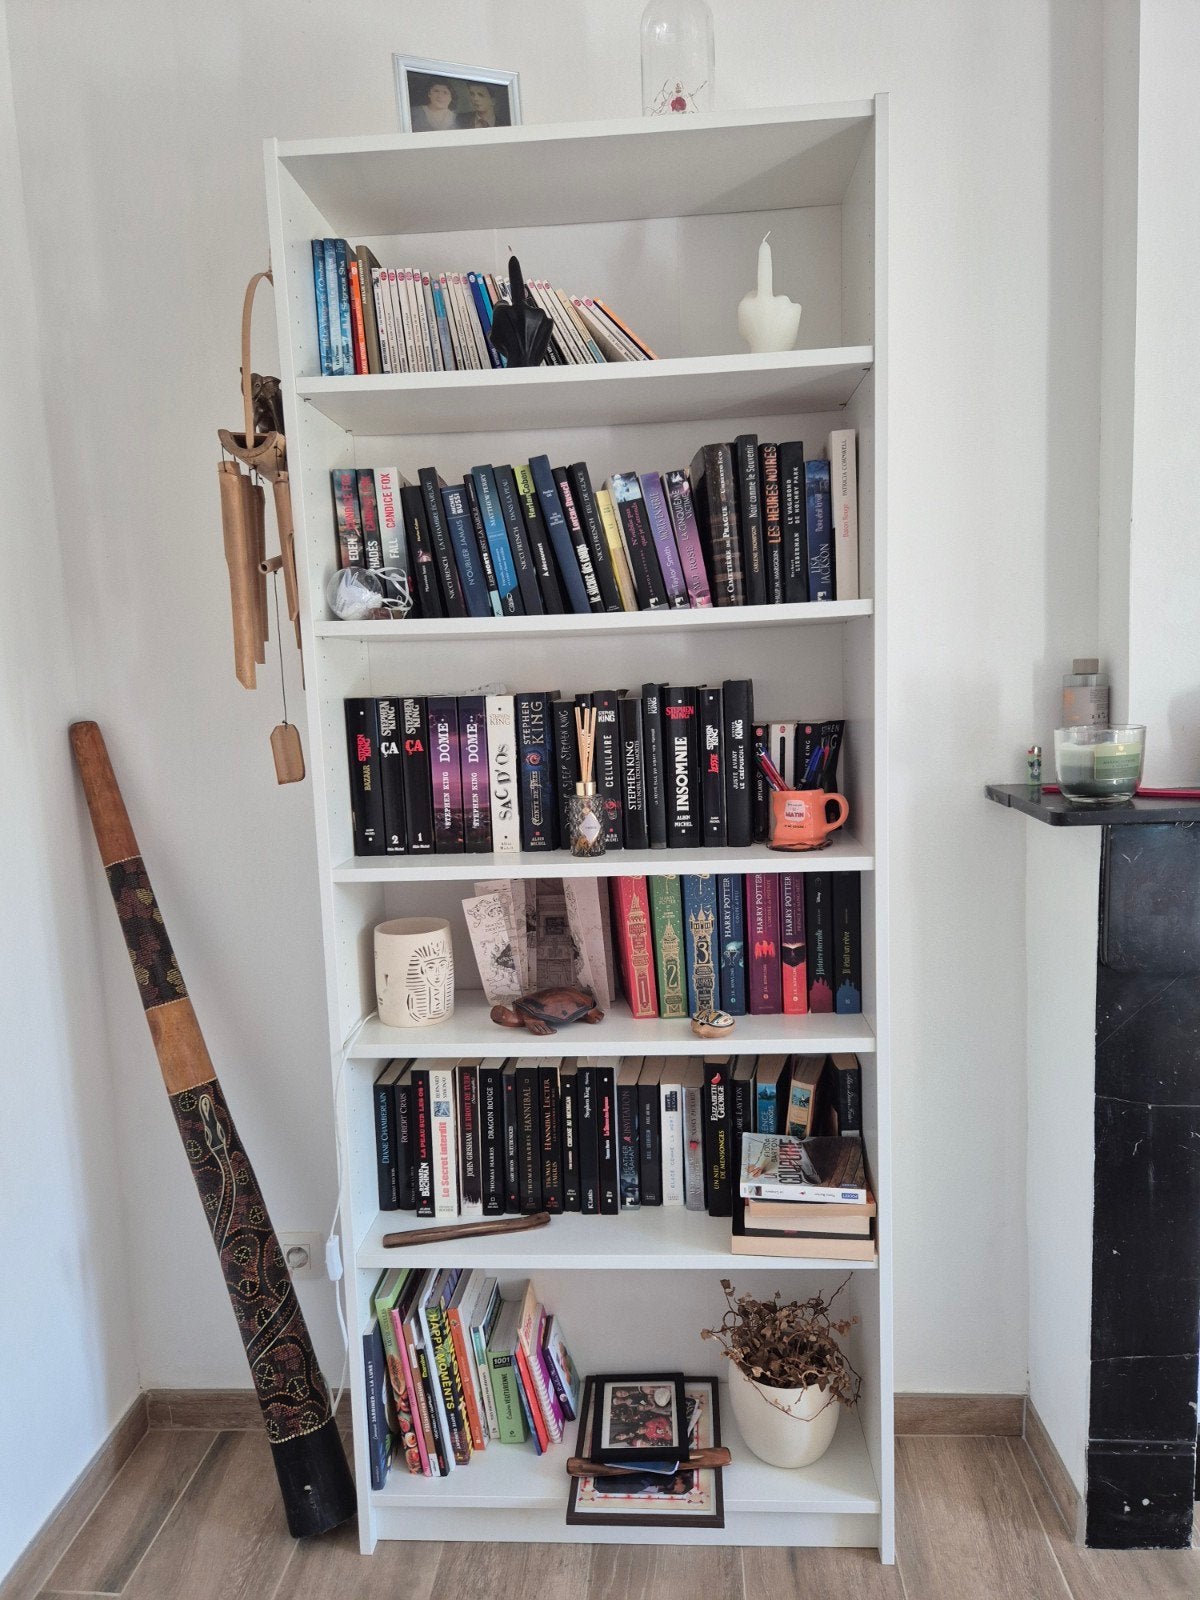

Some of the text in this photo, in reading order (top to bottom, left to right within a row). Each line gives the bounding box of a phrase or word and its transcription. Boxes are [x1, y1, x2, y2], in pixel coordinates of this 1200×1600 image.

[746, 444, 754, 472] Souvenir
[520, 470, 530, 494] Coben
[560, 482, 574, 506] Russell
[748, 481, 757, 502] comme
[764, 446, 781, 544] LES HEURES NOIRES
[341, 474, 356, 530] CANDICE FOX
[363, 495, 375, 531] CANDICE
[381, 473, 396, 528] CANDICE FOX
[449, 494, 457, 514] MICHEL
[453, 492, 464, 514] BUSSI
[480, 473, 497, 526] MATTHEW PERRY
[748, 504, 758, 517] Noir
[432, 511, 444, 541] CHAMBRE
[722, 506, 730, 538] PRAGUE
[347, 538, 359, 560] EDEN
[367, 540, 380, 568] HADÈS
[389, 538, 399, 558] FALL
[456, 519, 475, 585] N'OUBLIER JAMAIS
[537, 543, 548, 571] découvert
[483, 552, 492, 575] MORTS
[665, 546, 679, 588] Taylor Smith
[725, 549, 734, 593] CIMETIÈRE
[810, 556, 820, 574] LISA
[819, 543, 831, 583] JACKSON
[441, 556, 456, 599] NICCI FRENCH
[379, 701, 392, 736] STEPHEN
[387, 706, 396, 730] KING
[404, 698, 416, 734] STEPHEN
[411, 705, 421, 727] KING
[522, 702, 530, 745] STEPHEN
[531, 701, 544, 744] KING
[598, 714, 615, 722] KING
[734, 720, 743, 739] KING
[380, 742, 400, 758] ÇA
[405, 739, 424, 755] ÇA
[437, 723, 450, 762] DÔME
[466, 723, 479, 763] DÔME
[706, 725, 714, 750] STEPHEN
[711, 728, 719, 746] KING
[603, 735, 613, 787] CELLULAIRE
[674, 736, 689, 811] INSOMNIE
[363, 765, 371, 791] BAZAAR
[625, 741, 637, 810] STEPHEN KING
[443, 793, 451, 826] STEPHEN
[472, 793, 480, 827] STEPHEN
[494, 789, 513, 821] SAC
[392, 835, 399, 844] 2
[417, 833, 422, 841] 1
[784, 876, 792, 907] POTTER
[696, 940, 708, 964] 3
[524, 1087, 532, 1131] HANNIBAL
[717, 1085, 725, 1118] GEORGE
[379, 1092, 390, 1164] DIANE CHAMBERLAIN
[465, 1122, 472, 1130] LE
[544, 1111, 552, 1151] HANNIBAL
[421, 1149, 426, 1158] LA
[421, 1162, 430, 1197] BACHMAN
[440, 1157, 449, 1186] Secret
[467, 1161, 475, 1177] JOHN
[720, 1170, 726, 1179] DE
[441, 1188, 449, 1198] Le
[714, 1179, 720, 1189] UN
[427, 1313, 455, 1411] HAPPY MOMENTS
[493, 1356, 510, 1364] 1001
[369, 1379, 374, 1387] LA
